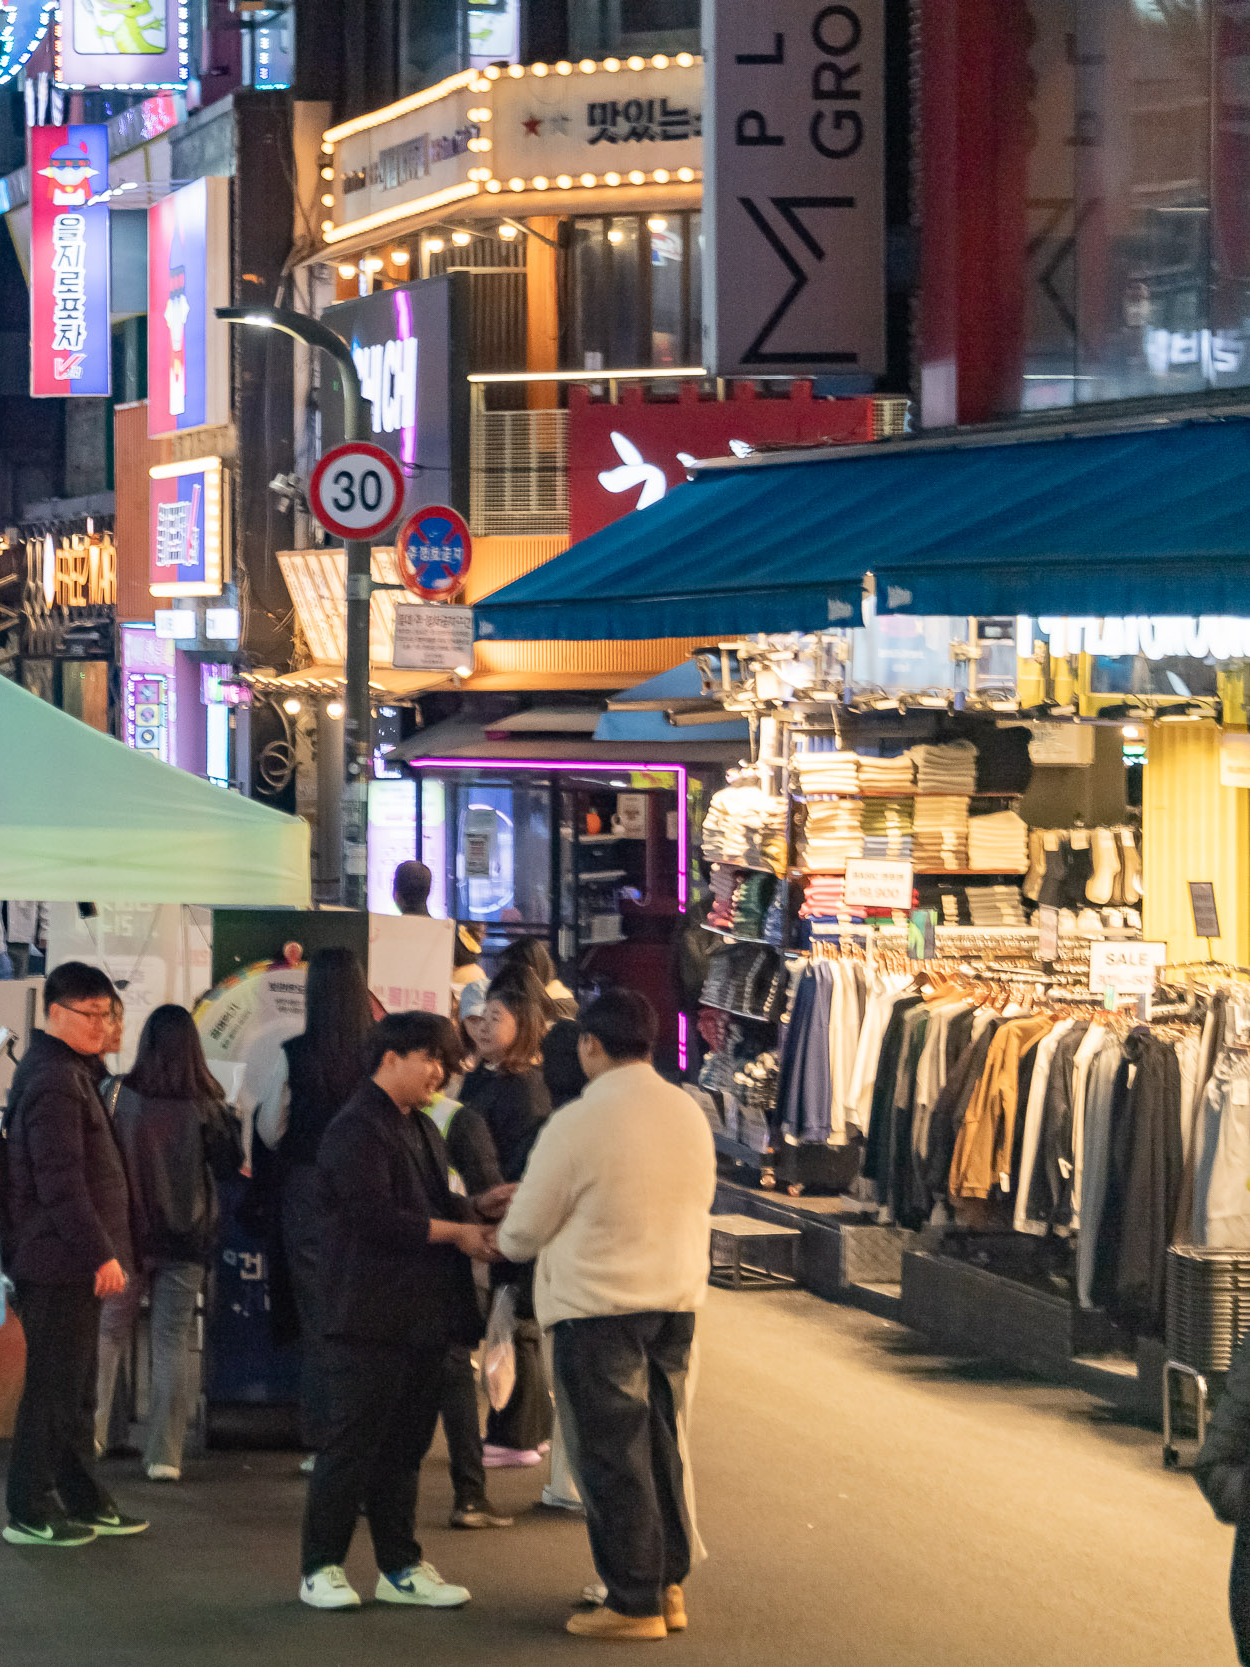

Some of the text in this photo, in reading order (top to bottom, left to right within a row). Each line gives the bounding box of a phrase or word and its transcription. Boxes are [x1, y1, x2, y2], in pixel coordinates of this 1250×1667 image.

[54, 214, 85, 350] 을지로포차
[332, 470, 382, 513] 30
[1105, 952, 1149, 966] SALE
